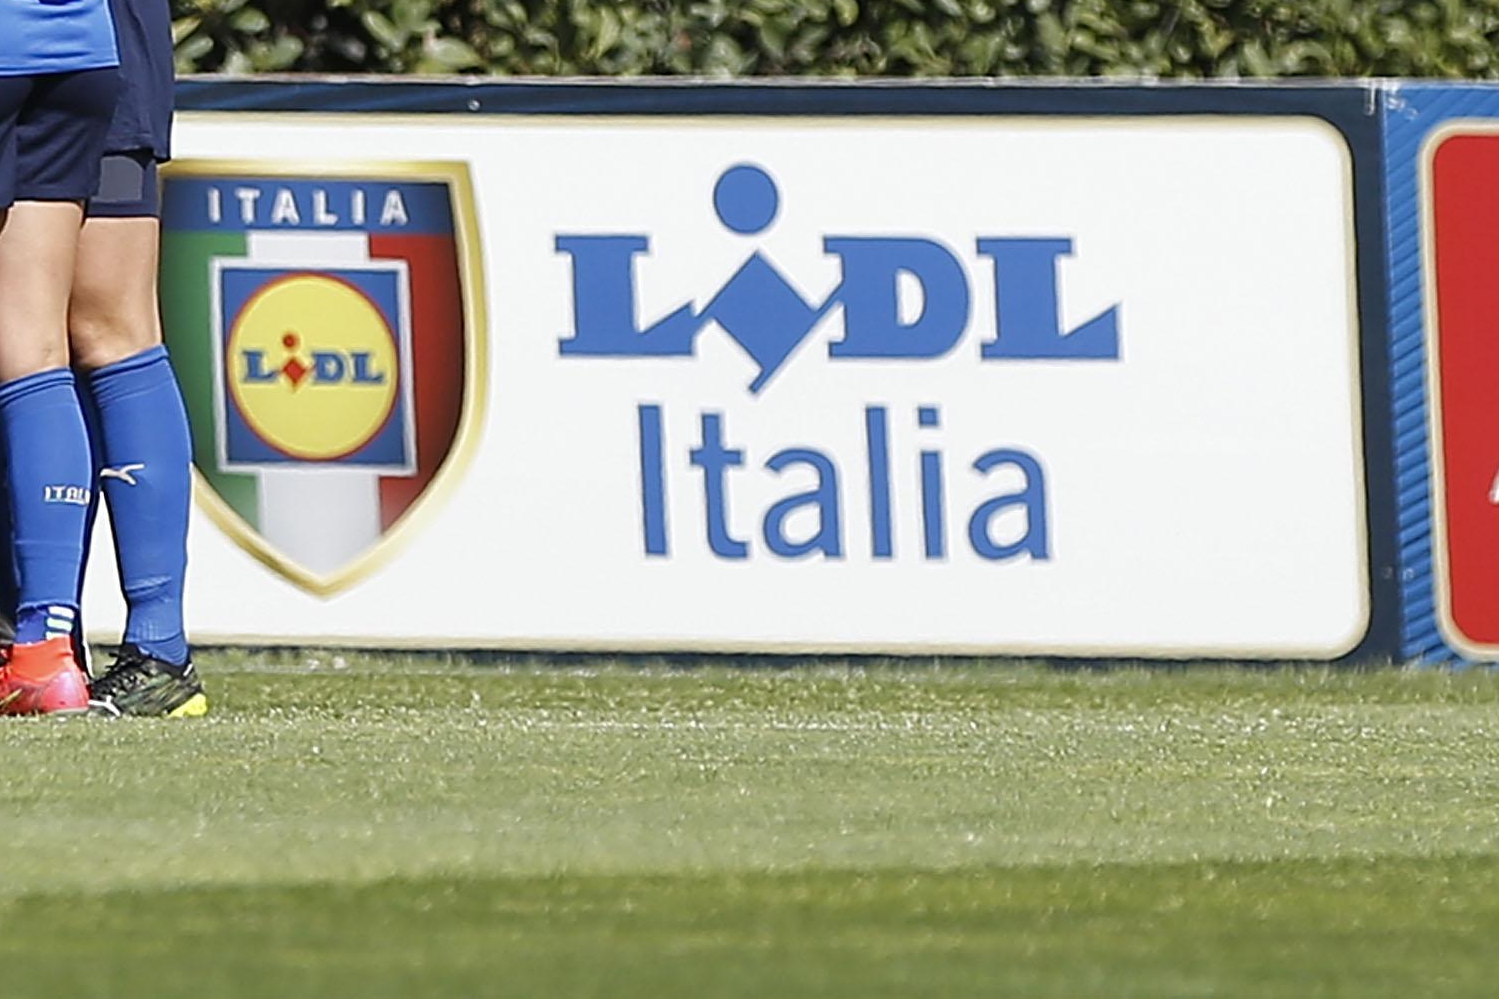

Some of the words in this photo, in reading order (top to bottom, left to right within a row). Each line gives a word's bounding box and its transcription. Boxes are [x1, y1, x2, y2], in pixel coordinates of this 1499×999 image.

[208, 186, 410, 226] ITALIA
[45, 486, 90, 505] ITALI
[637, 403, 1051, 561] Italia
